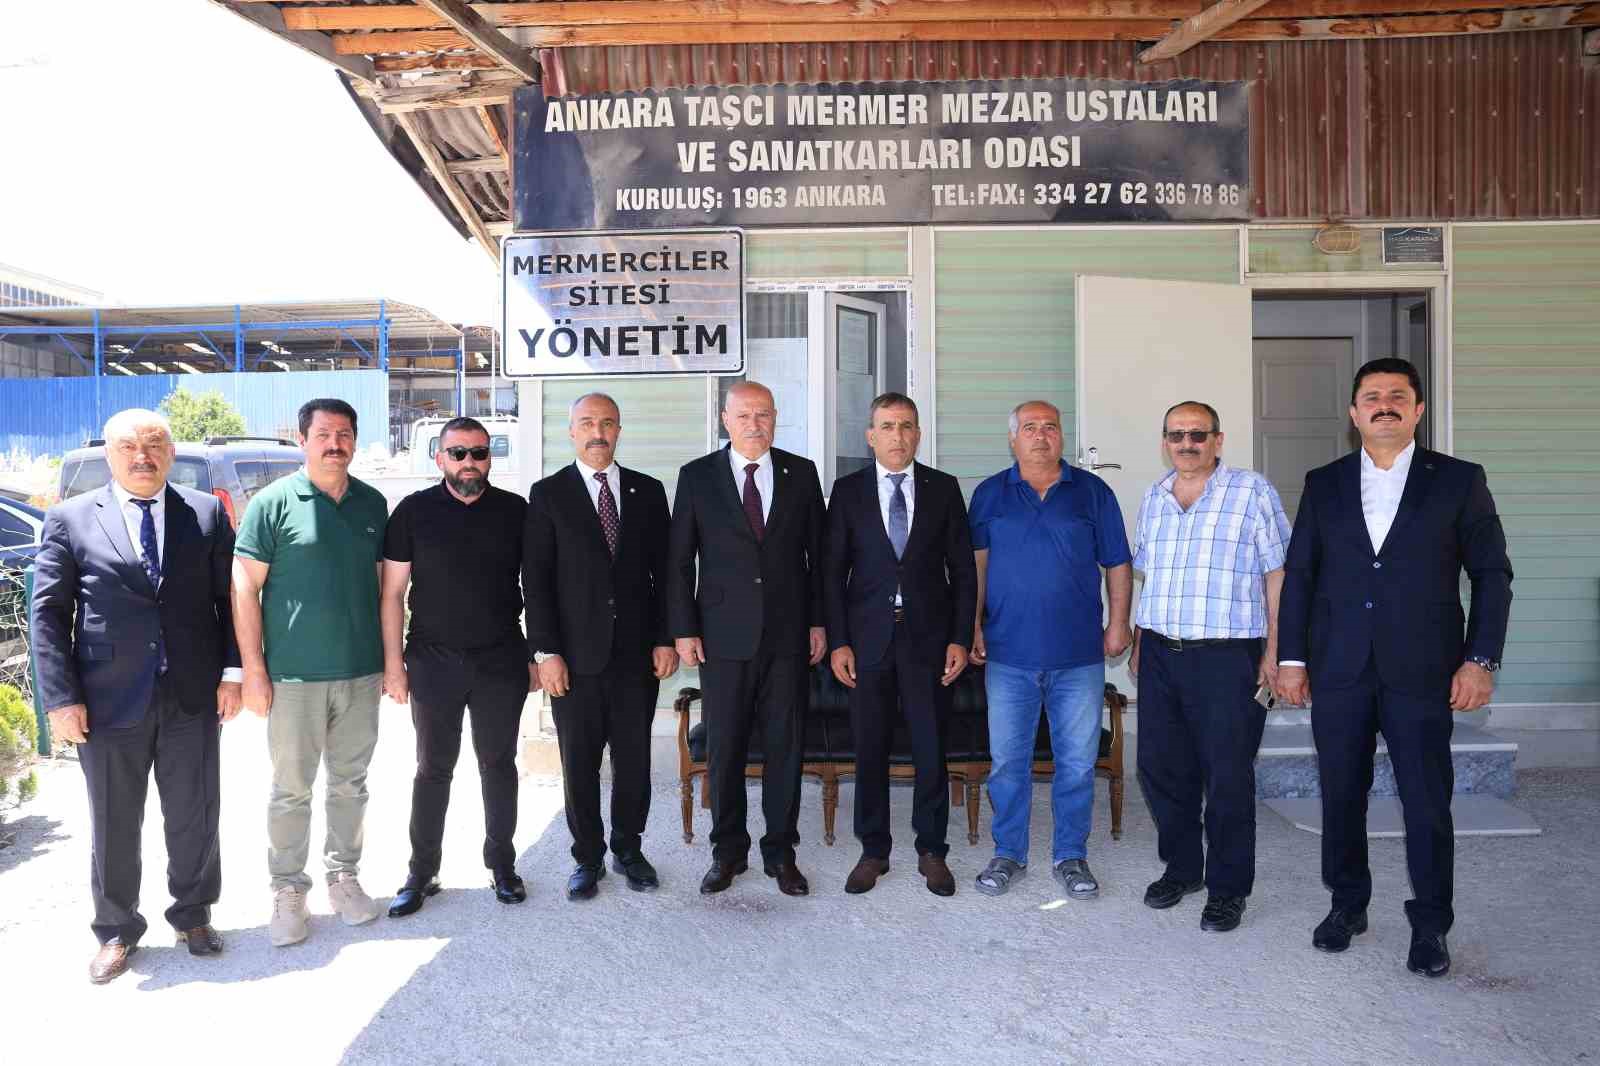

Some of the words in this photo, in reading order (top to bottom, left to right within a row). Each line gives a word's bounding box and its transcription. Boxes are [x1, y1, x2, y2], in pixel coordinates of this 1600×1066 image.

[544, 96, 675, 133] ANKARA
[683, 95, 775, 131] TAŞCI
[787, 94, 929, 126] MERMER
[941, 91, 1053, 124] MEZAR
[1066, 89, 1218, 122] USTALARI
[677, 141, 716, 173] VE
[728, 137, 972, 172] SANATKARLARI
[984, 135, 1081, 169] ODASI
[616, 186, 723, 213] KURULUŞ:
[732, 186, 788, 209] 1963
[793, 184, 887, 209] ANKARA
[1033, 182, 1077, 205] 334
[1084, 182, 1112, 205] 27
[1120, 182, 1147, 205] 62
[1155, 182, 1186, 205] 336
[1191, 183, 1213, 206] 78
[1218, 184, 1239, 206] 86
[512, 245, 729, 276] MERMERCİLER
[568, 278, 671, 307] SİTESİ
[517, 315, 728, 359] YÖNETİM
